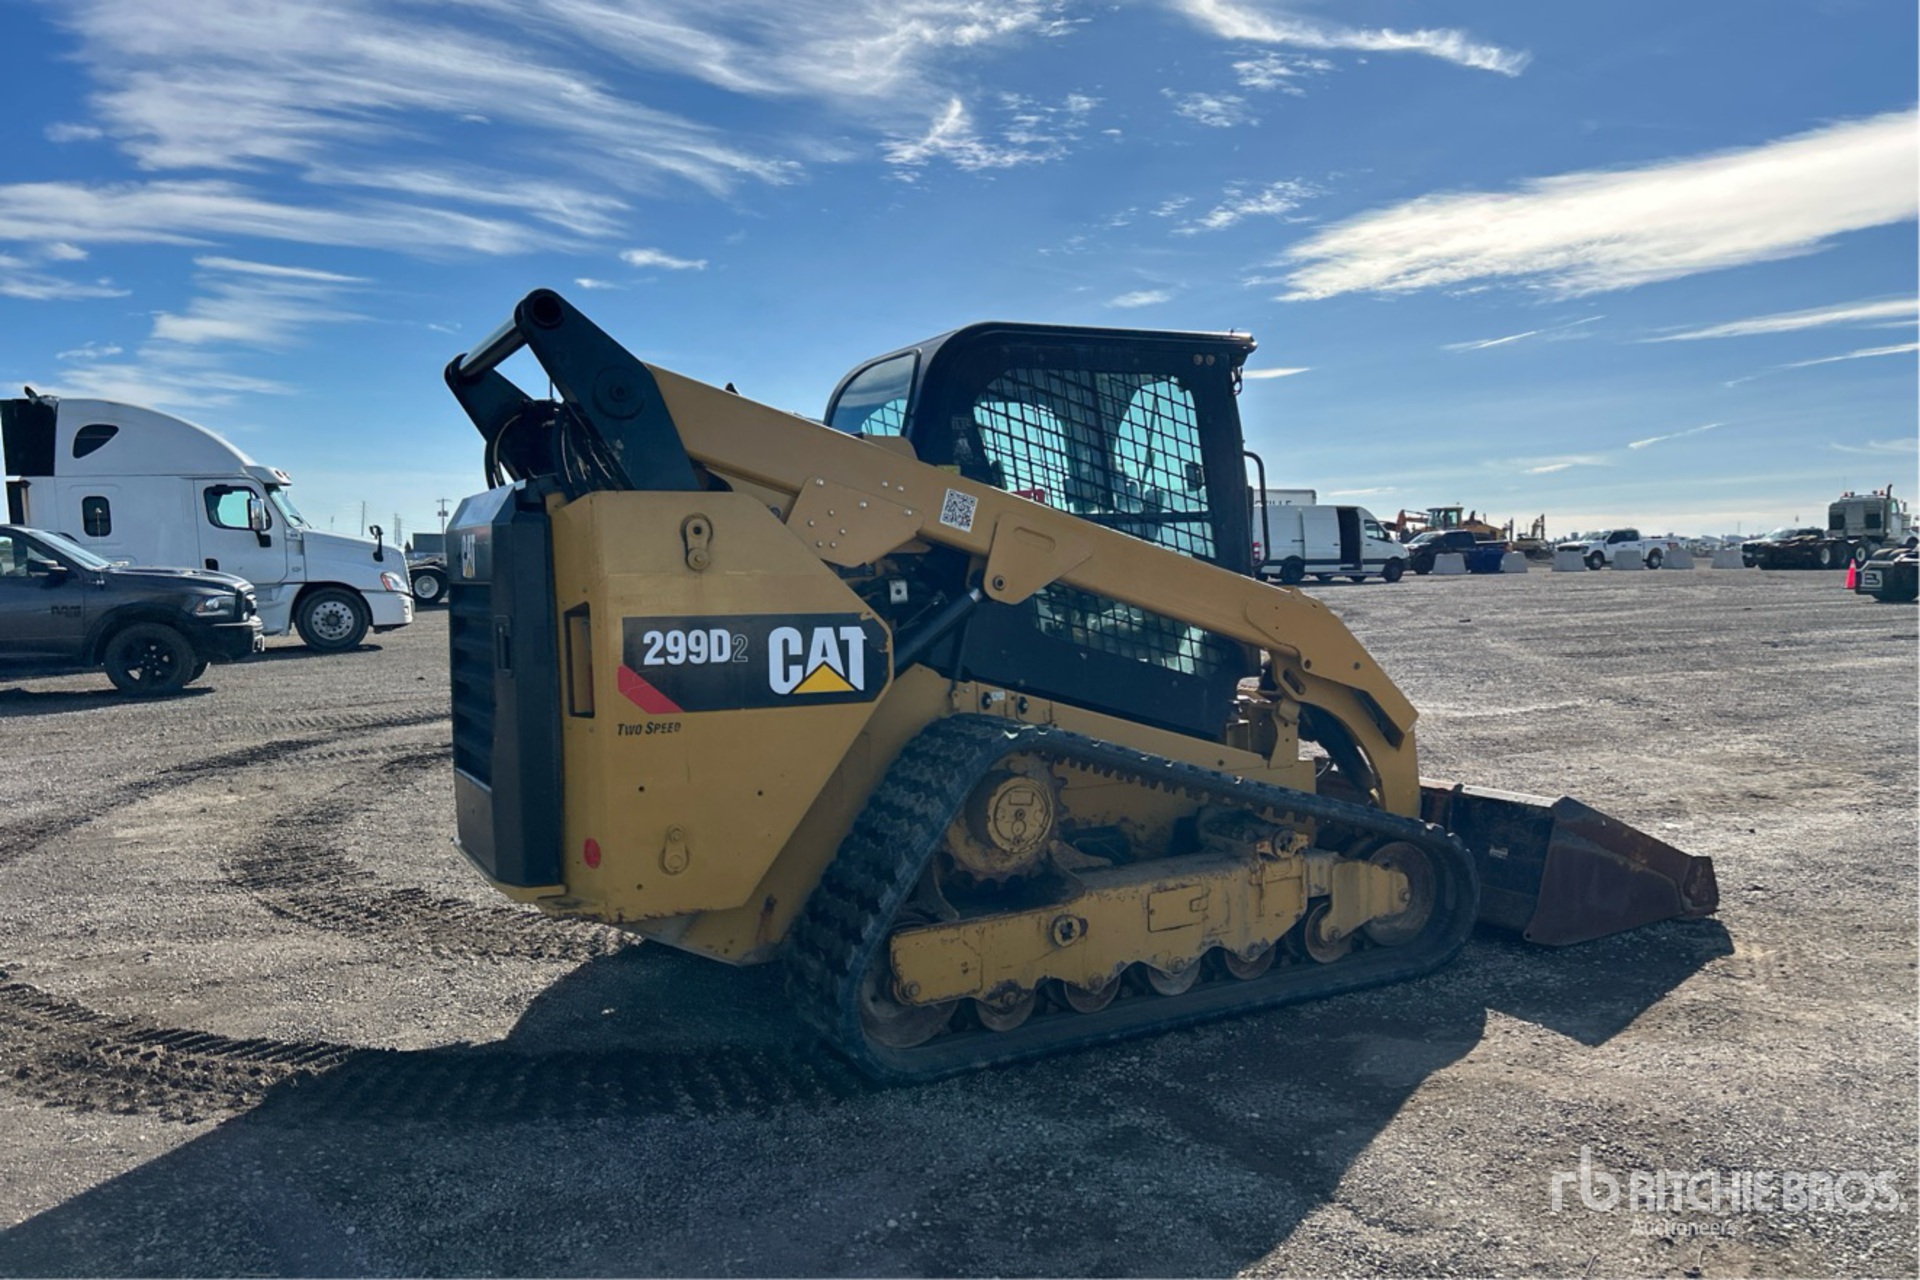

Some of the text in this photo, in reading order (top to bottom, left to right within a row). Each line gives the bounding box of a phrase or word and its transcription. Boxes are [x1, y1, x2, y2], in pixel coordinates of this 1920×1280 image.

[768, 626, 867, 695] CAT
[617, 721, 682, 737] TWO SPEED
